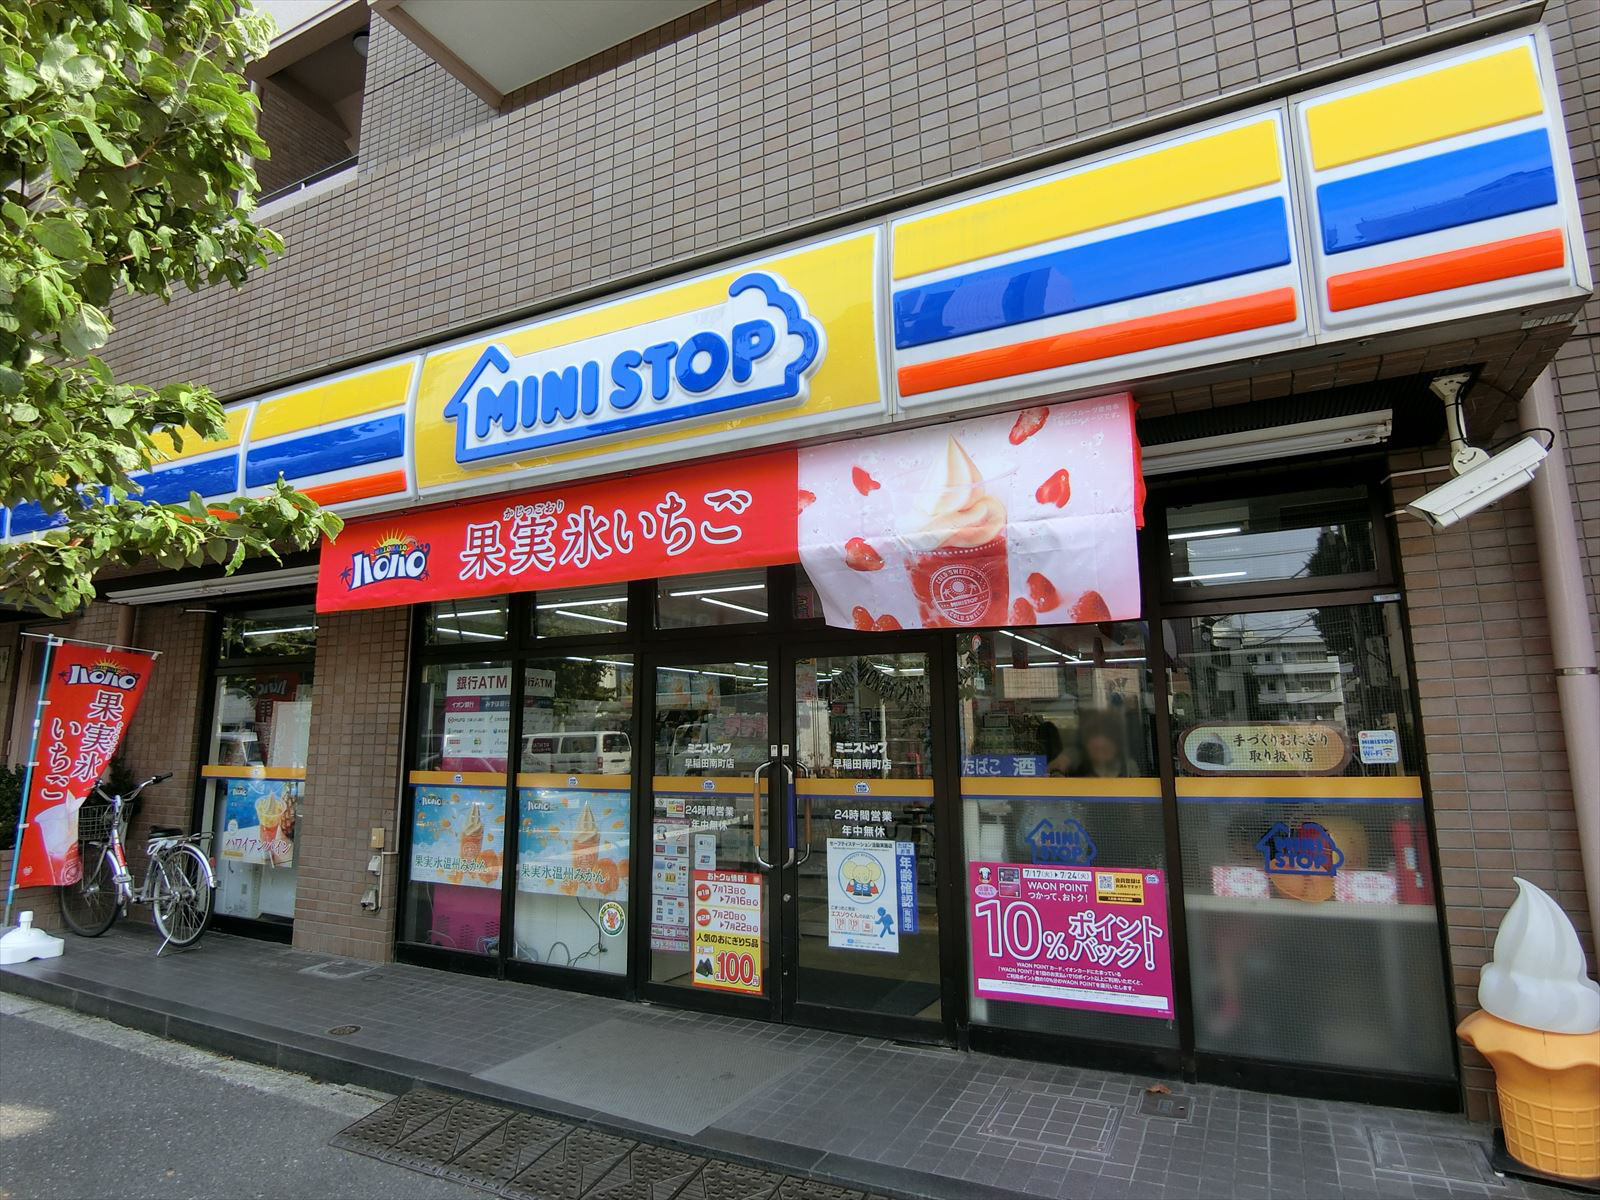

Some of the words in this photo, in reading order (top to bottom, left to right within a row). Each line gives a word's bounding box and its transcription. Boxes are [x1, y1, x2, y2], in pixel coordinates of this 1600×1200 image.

[475, 360, 600, 439] MINI
[609, 319, 776, 410] STOP
[502, 499, 565, 521] かじつごおり
[459, 490, 753, 581] 果実氷いちご
[456, 675, 509, 690] 銀行ATM
[70, 689, 124, 782] 果実氷
[1233, 733, 1329, 747] 手づくりおにぎり
[687, 742, 732, 754] ミニストップ
[835, 742, 888, 754] ミニストップ
[1363, 749, 1383, 757] Wi-Fi
[41, 717, 82, 800] いちご
[1249, 749, 1314, 763] 取り扱い店
[684, 758, 735, 769] 早稲田南町店
[833, 758, 892, 770] 早稲田南町店
[962, 757, 1001, 775] たばこ
[1012, 757, 1037, 776] 酒
[685, 805, 734, 817] 24時間営業
[834, 809, 892, 822] 24時間営業
[691, 819, 728, 831] 年中無休
[841, 824, 886, 838] 年中無休
[1274, 851, 1326, 869] STOP
[899, 856, 914, 907] 年齢確認
[1027, 881, 1058, 890] WAON
[1059, 883, 1089, 892] POINT
[712, 884, 747, 895] 7月13日
[1027, 892, 1089, 903] つかって、おトク!
[712, 909, 747, 921] 7月20日
[975, 899, 1069, 961] 10%
[1067, 909, 1163, 944] ポイント
[696, 932, 759, 948] 人気のおにぎり5品
